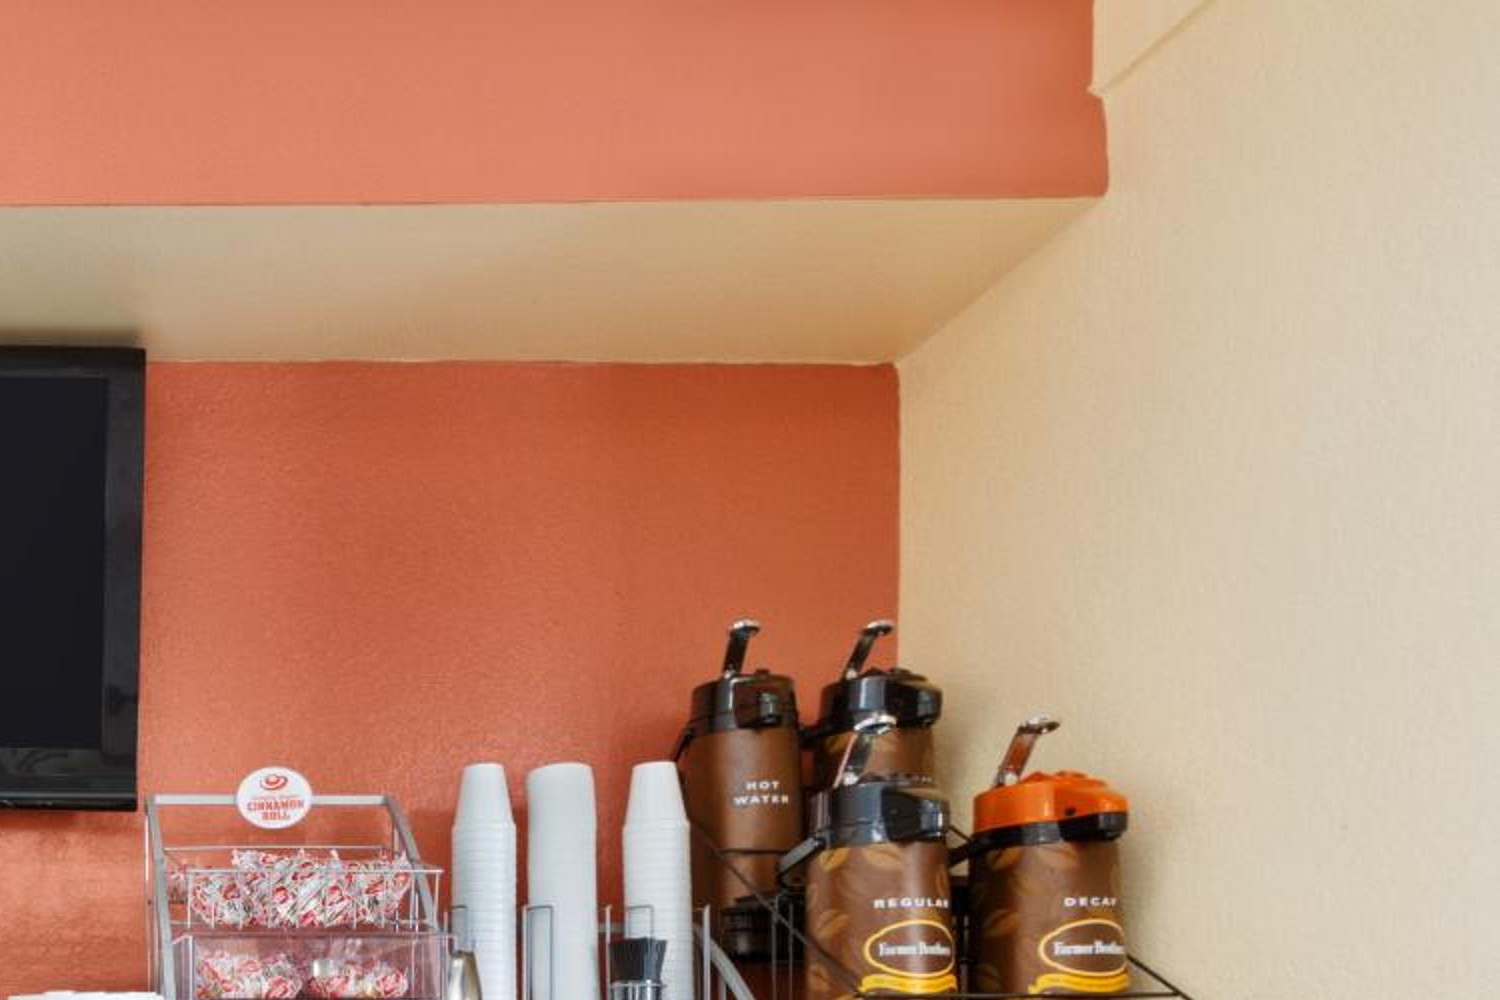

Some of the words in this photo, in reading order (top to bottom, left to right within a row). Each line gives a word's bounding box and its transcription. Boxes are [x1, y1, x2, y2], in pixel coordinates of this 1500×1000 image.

[746, 780, 780, 791] HOT
[733, 794, 789, 805] WATER
[247, 799, 304, 812] CINNAMON
[261, 811, 291, 821] ROLL
